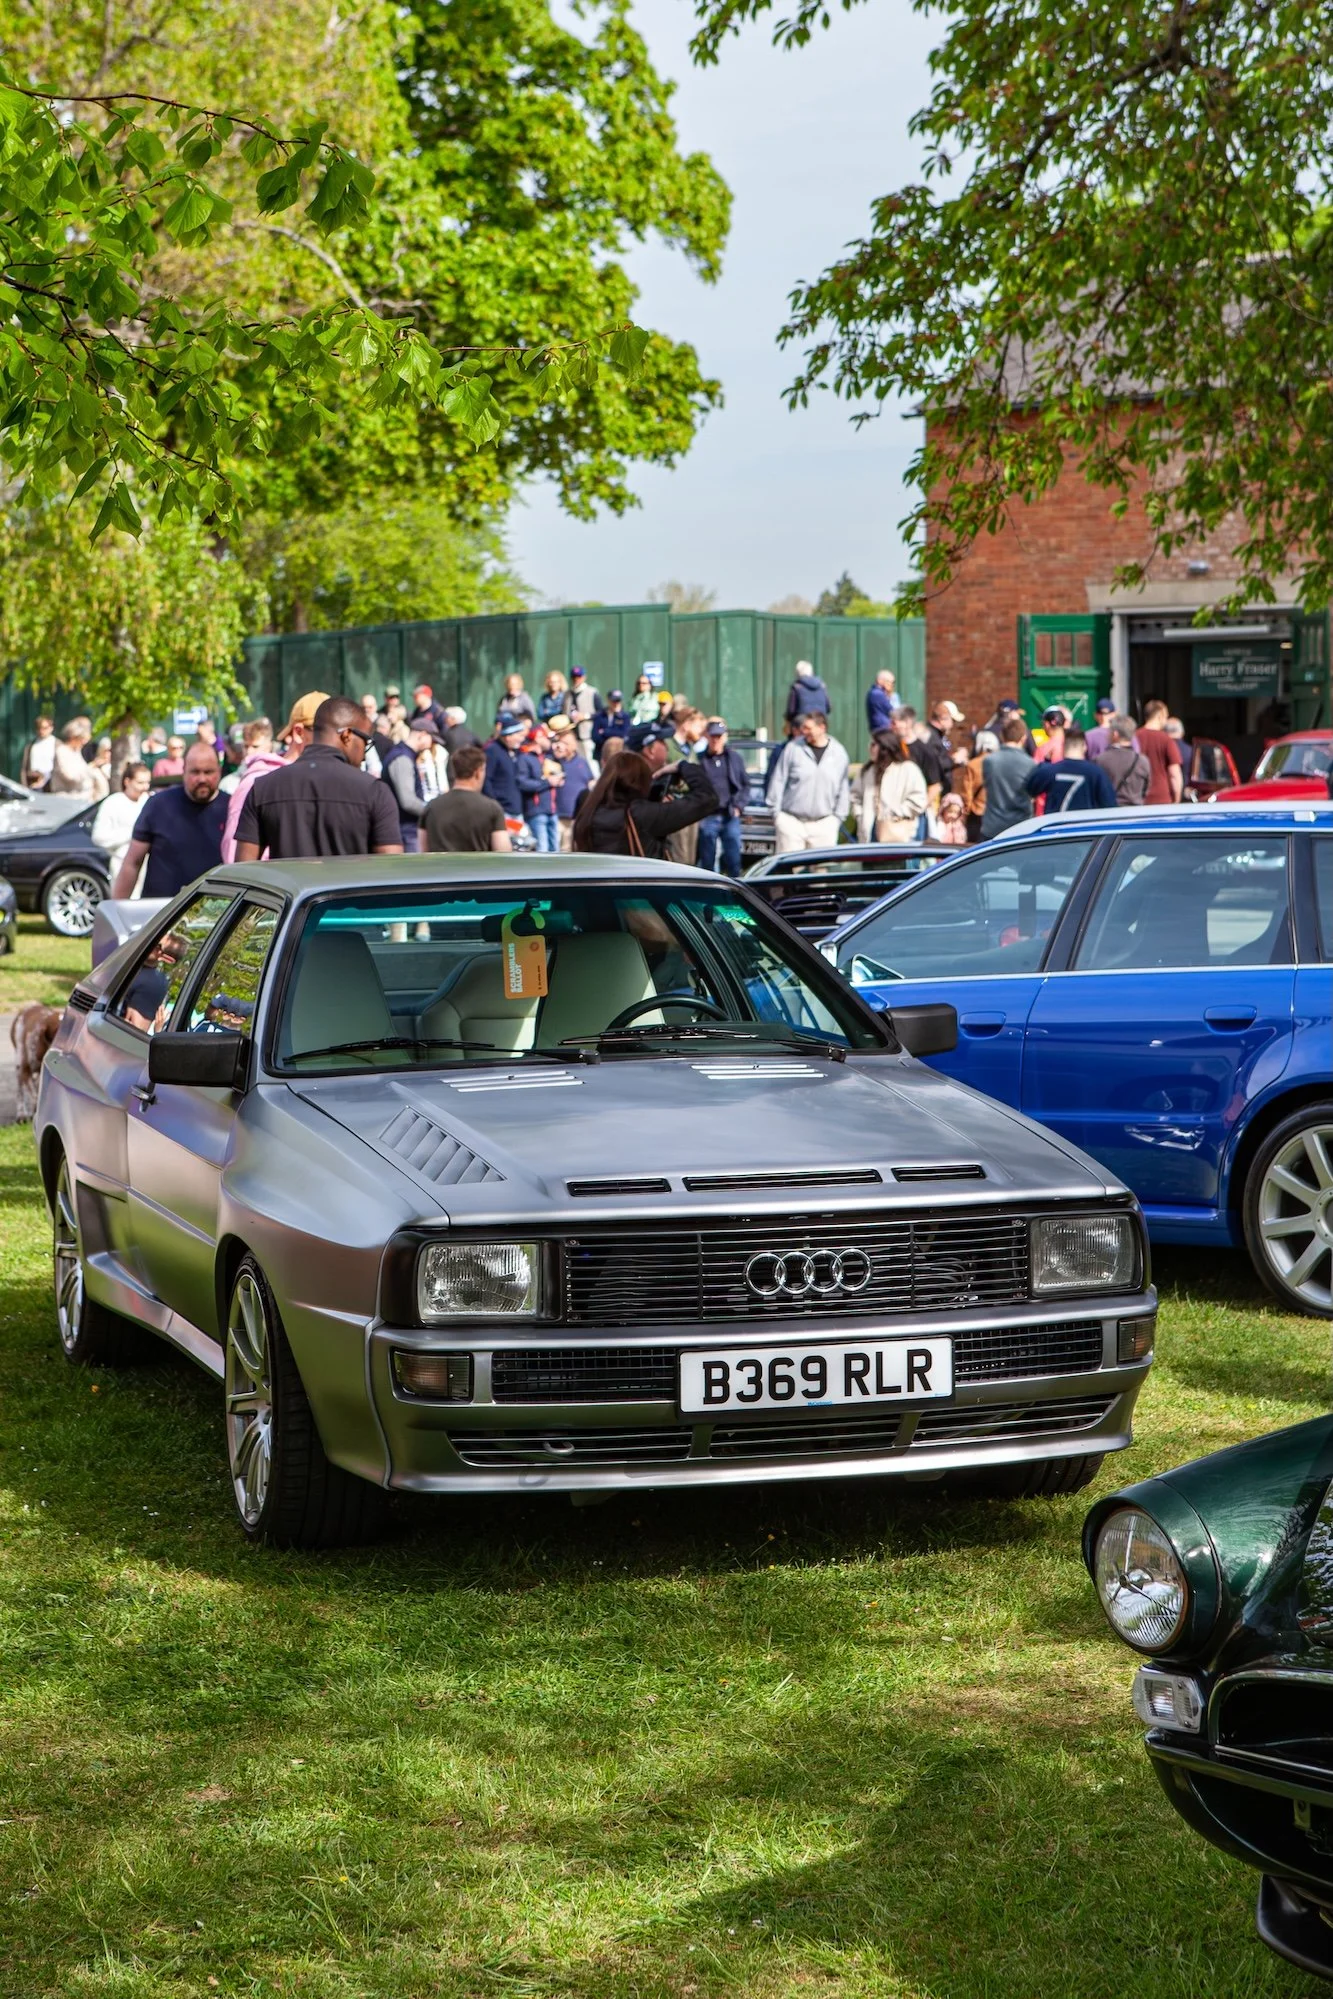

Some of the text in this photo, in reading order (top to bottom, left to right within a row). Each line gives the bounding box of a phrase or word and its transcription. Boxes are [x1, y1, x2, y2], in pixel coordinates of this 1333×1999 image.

[1199, 661, 1278, 679] Harry Fraser
[1054, 773, 1086, 813] 7
[508, 943, 517, 993] SCRAMBLERS
[515, 964, 523, 993] BALLOT
[702, 1348, 933, 1405] B369 RLR
